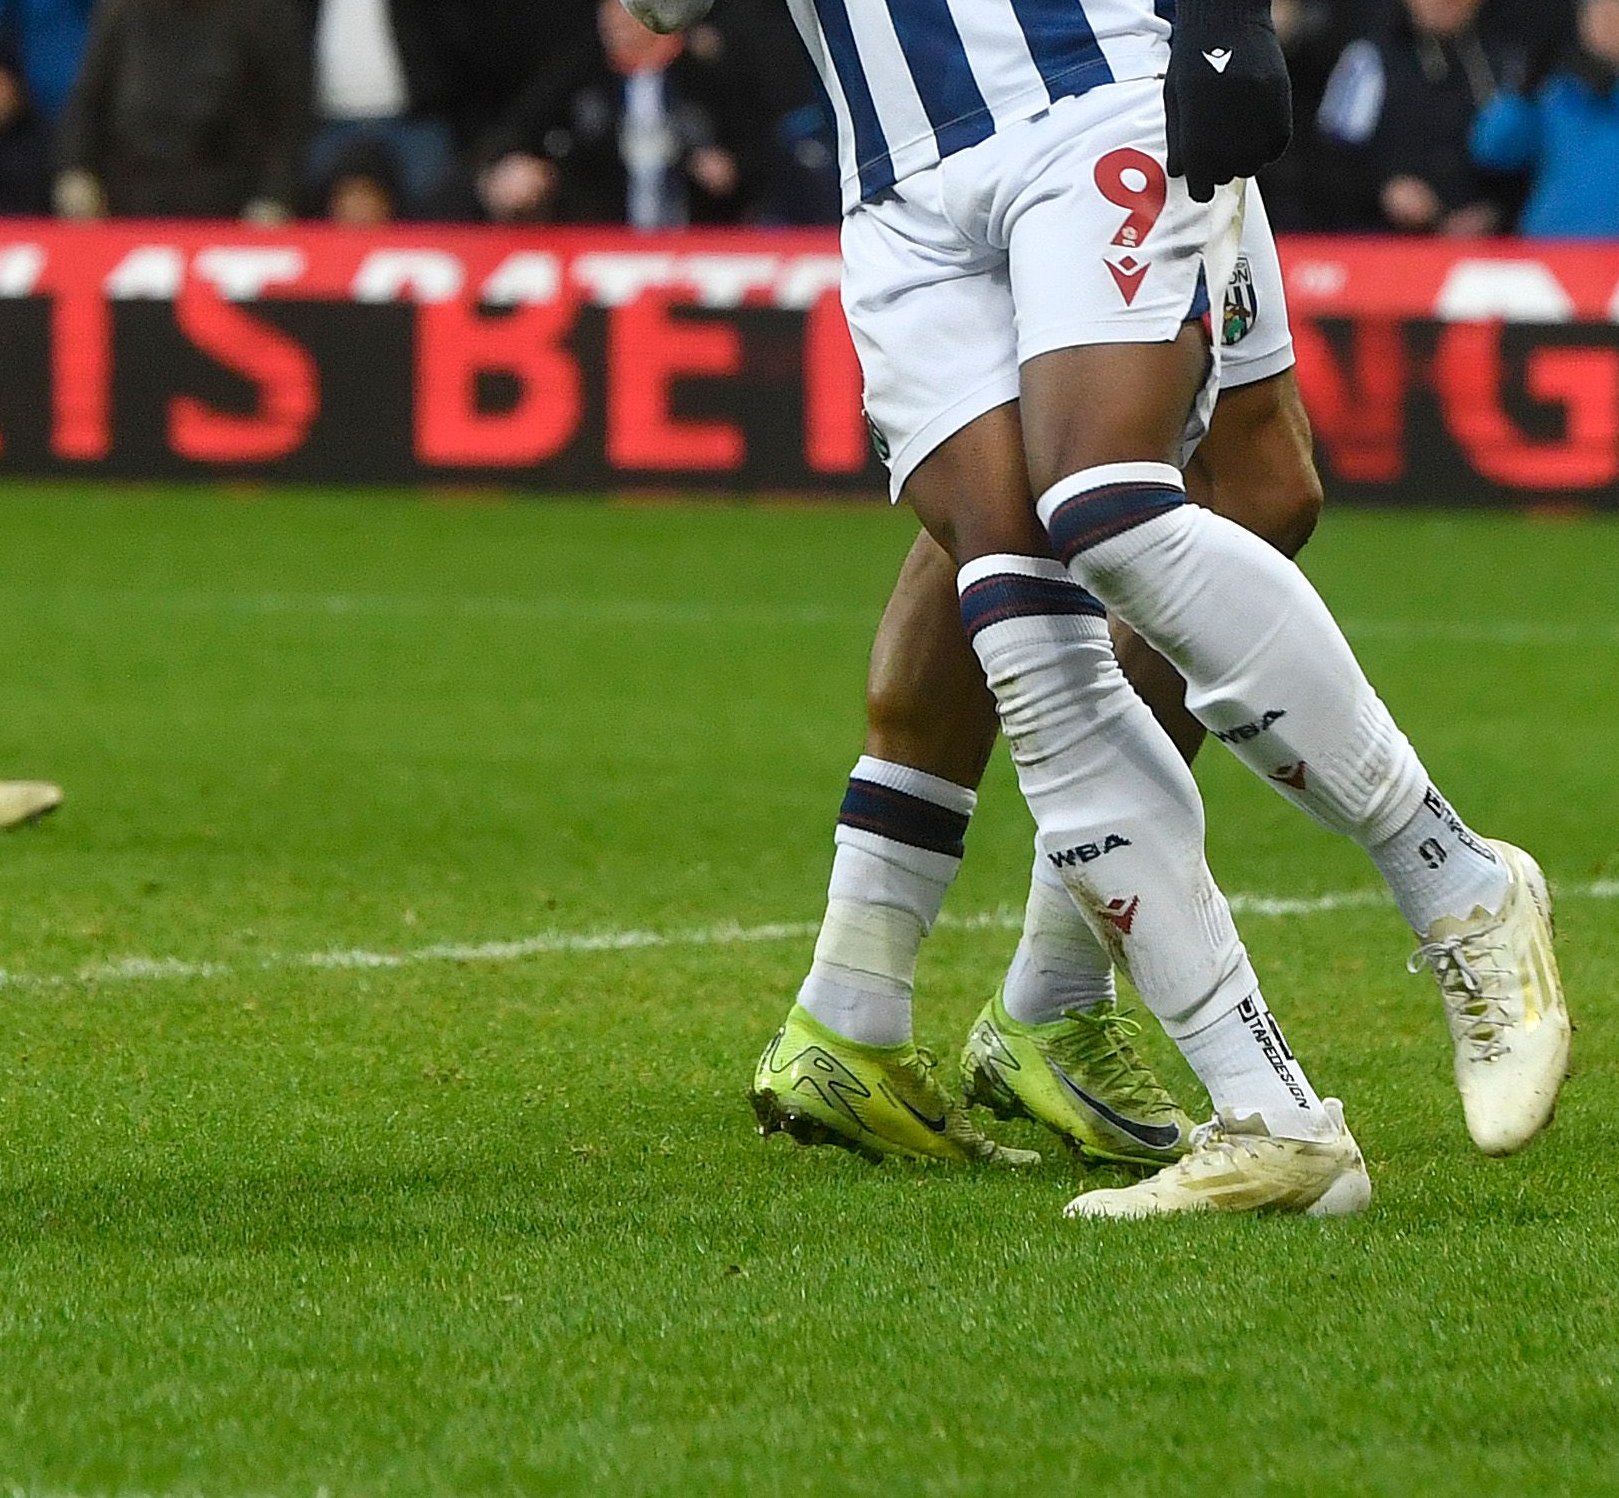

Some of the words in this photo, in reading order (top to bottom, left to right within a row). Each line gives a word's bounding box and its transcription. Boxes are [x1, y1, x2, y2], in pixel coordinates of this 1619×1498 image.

[1093, 147, 1167, 248] 9
[1213, 708, 1286, 744] WBA
[1048, 834, 1132, 868] WBA
[1249, 1018, 1310, 1110] TAPEDESIGN
